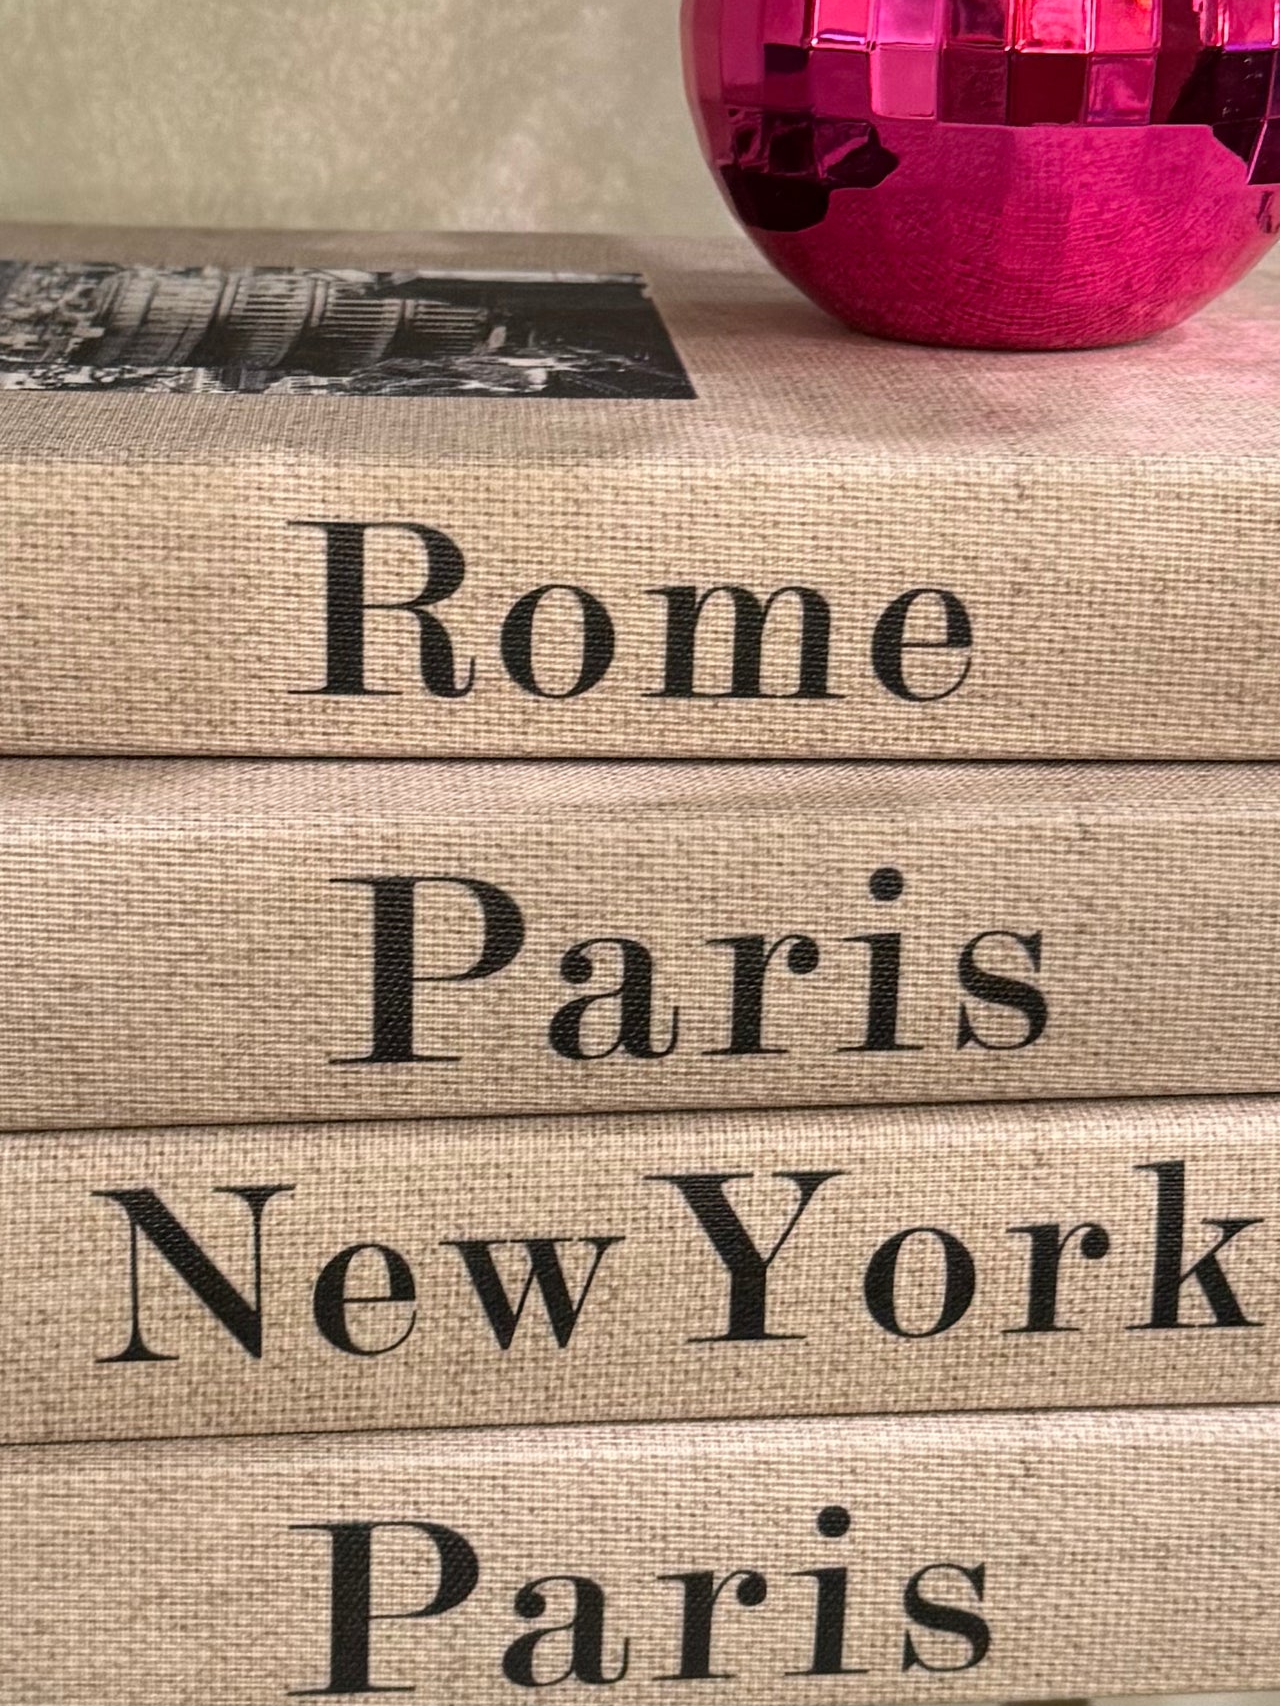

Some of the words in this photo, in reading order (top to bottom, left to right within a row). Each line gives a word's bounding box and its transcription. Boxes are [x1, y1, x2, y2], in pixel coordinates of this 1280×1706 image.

[286, 521, 973, 702] Rome
[327, 867, 1048, 1065] Paris
[90, 1183, 625, 1364] New
[644, 1159, 1269, 1345] York
[287, 1505, 993, 1696] Paris
